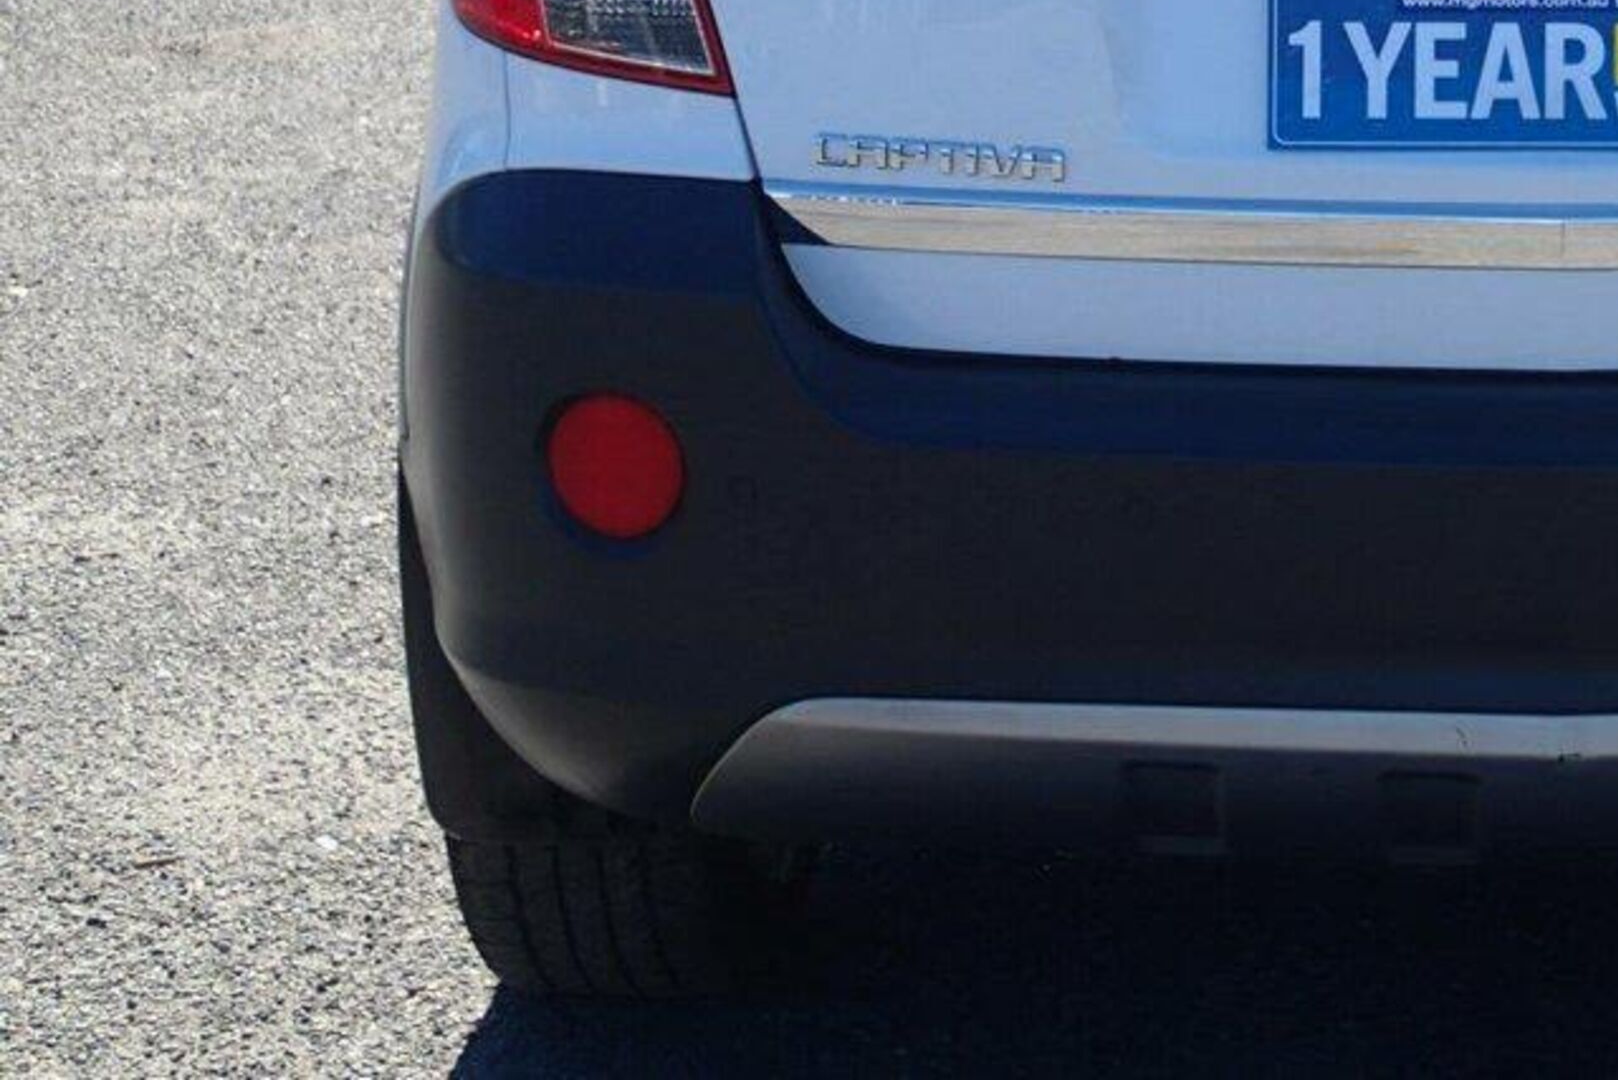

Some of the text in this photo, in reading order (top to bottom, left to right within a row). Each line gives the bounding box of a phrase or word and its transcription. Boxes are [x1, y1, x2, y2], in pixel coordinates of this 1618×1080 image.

[1288, 20, 1322, 120] 1
[1342, 20, 1608, 120] YEAR
[814, 131, 1066, 183] CAPTIVA
